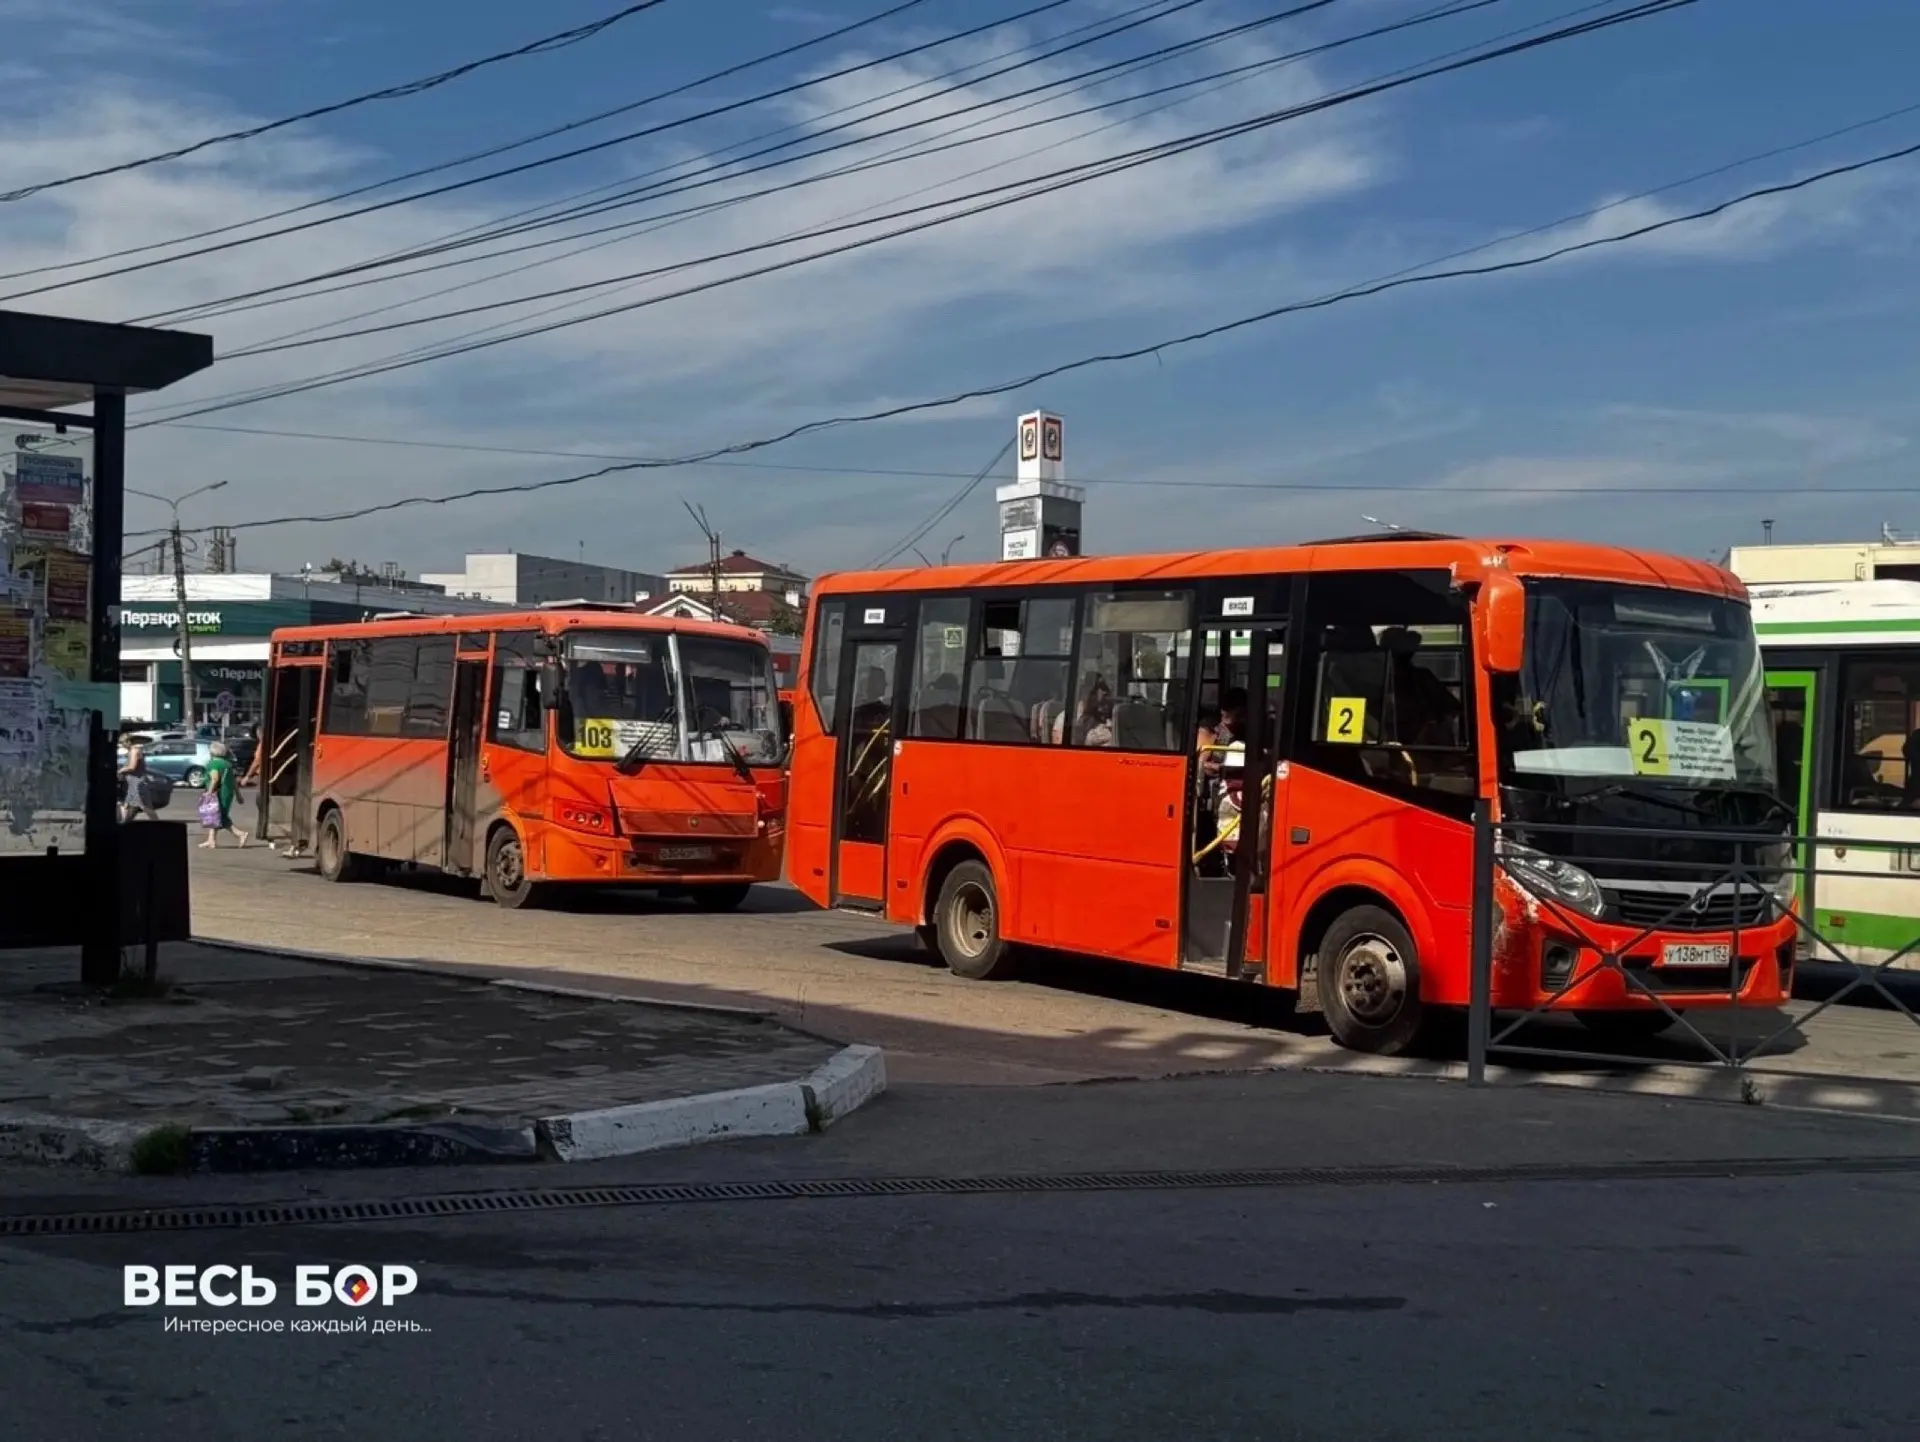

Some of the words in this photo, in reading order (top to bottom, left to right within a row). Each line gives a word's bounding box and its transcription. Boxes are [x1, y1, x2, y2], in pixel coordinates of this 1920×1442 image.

[1338, 707, 1354, 735] 2
[580, 726, 612, 749] 103
[1639, 729, 1660, 763] 2
